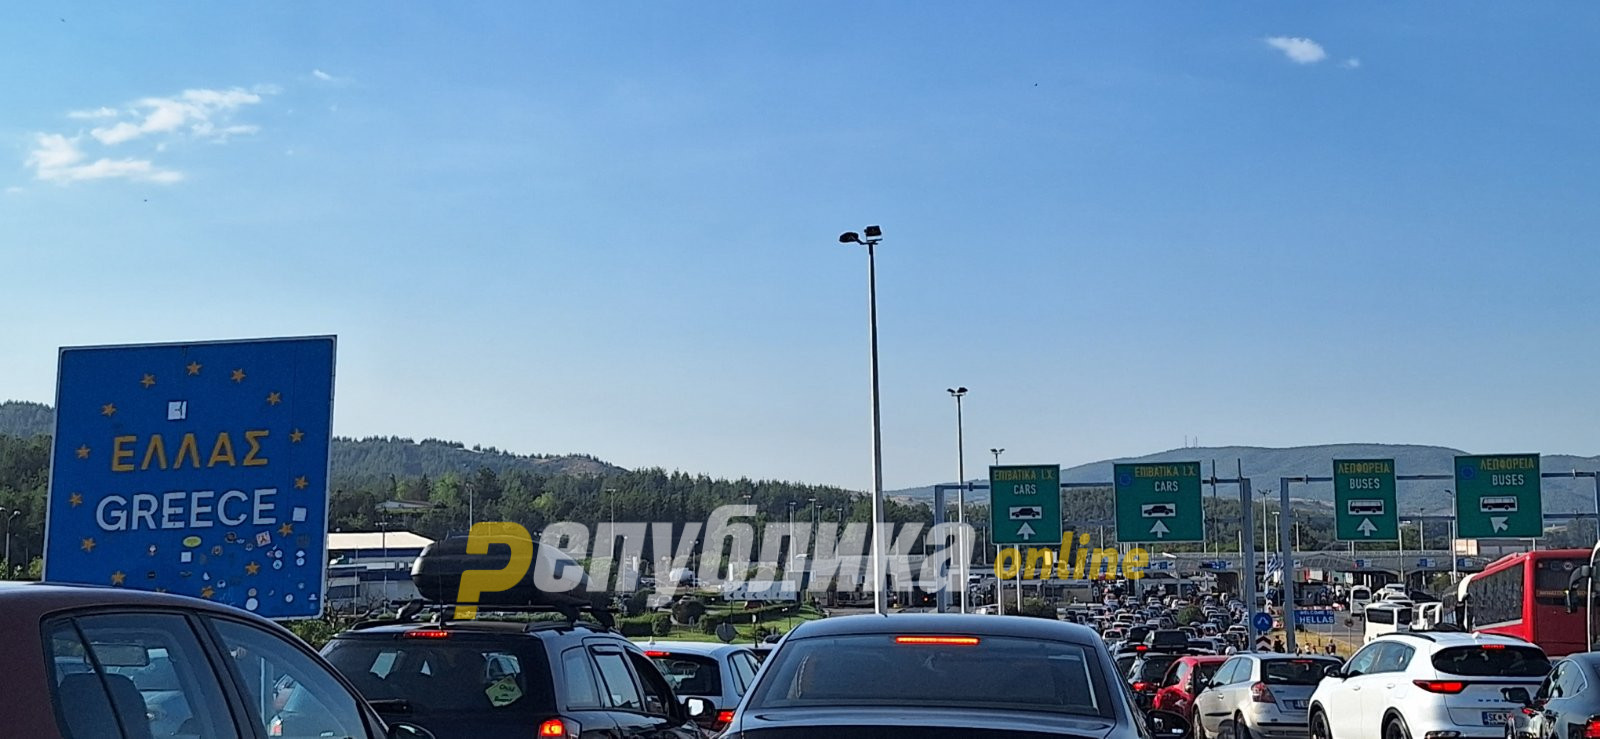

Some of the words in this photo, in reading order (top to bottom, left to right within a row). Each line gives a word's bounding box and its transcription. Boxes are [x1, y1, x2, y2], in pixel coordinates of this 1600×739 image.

[111, 430, 270, 472] ΕΛΛΑΣ
[1154, 480, 1179, 492] CARS
[1349, 478, 1380, 489] BUSES
[1492, 474, 1524, 486] BUSES
[1013, 484, 1037, 495] CARS
[95, 488, 278, 532] GREECE
[1299, 616, 1334, 624] HELLAS
